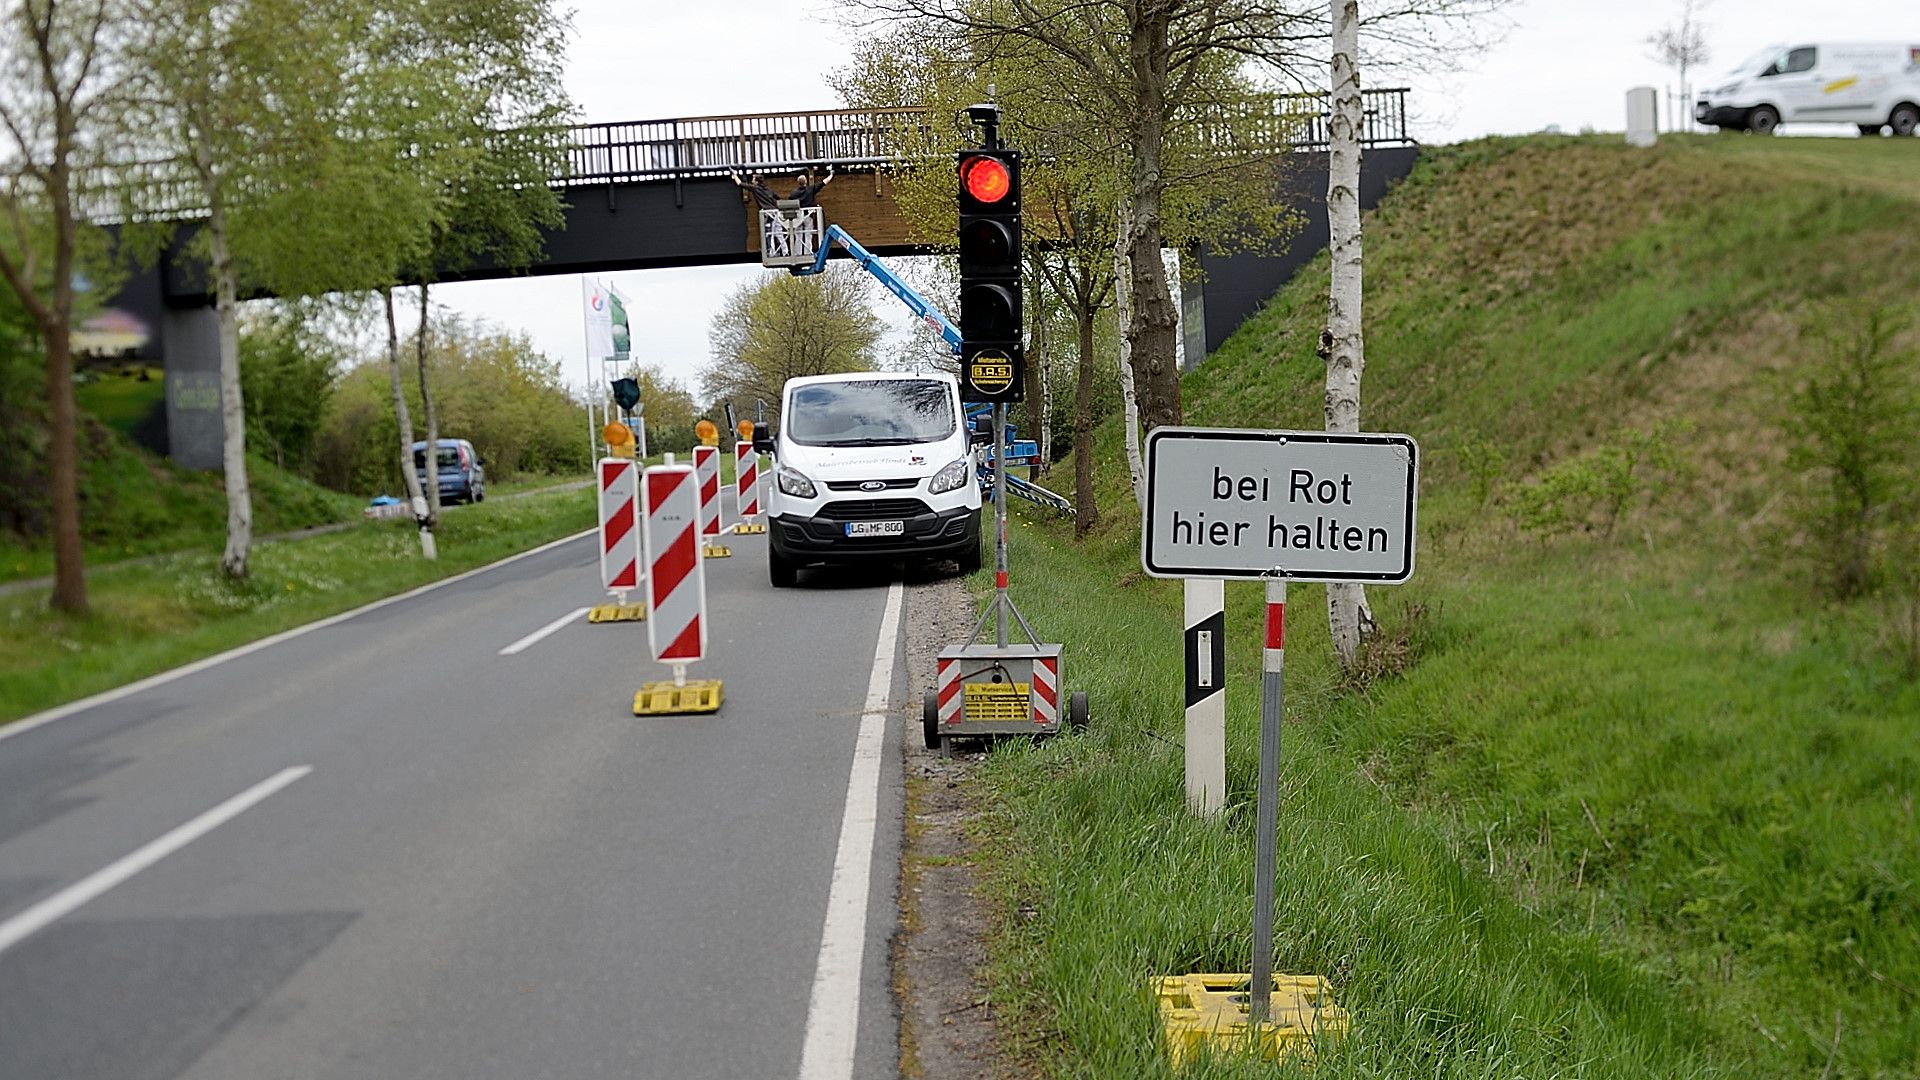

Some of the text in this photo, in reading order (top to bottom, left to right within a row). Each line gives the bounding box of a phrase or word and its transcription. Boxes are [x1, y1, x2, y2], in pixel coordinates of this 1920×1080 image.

[974, 367, 1009, 376] B.A.S.
[1212, 466, 1353, 505] bei Rot
[851, 522, 903, 534] LG MF 800
[1172, 510, 1388, 552] hier halten
